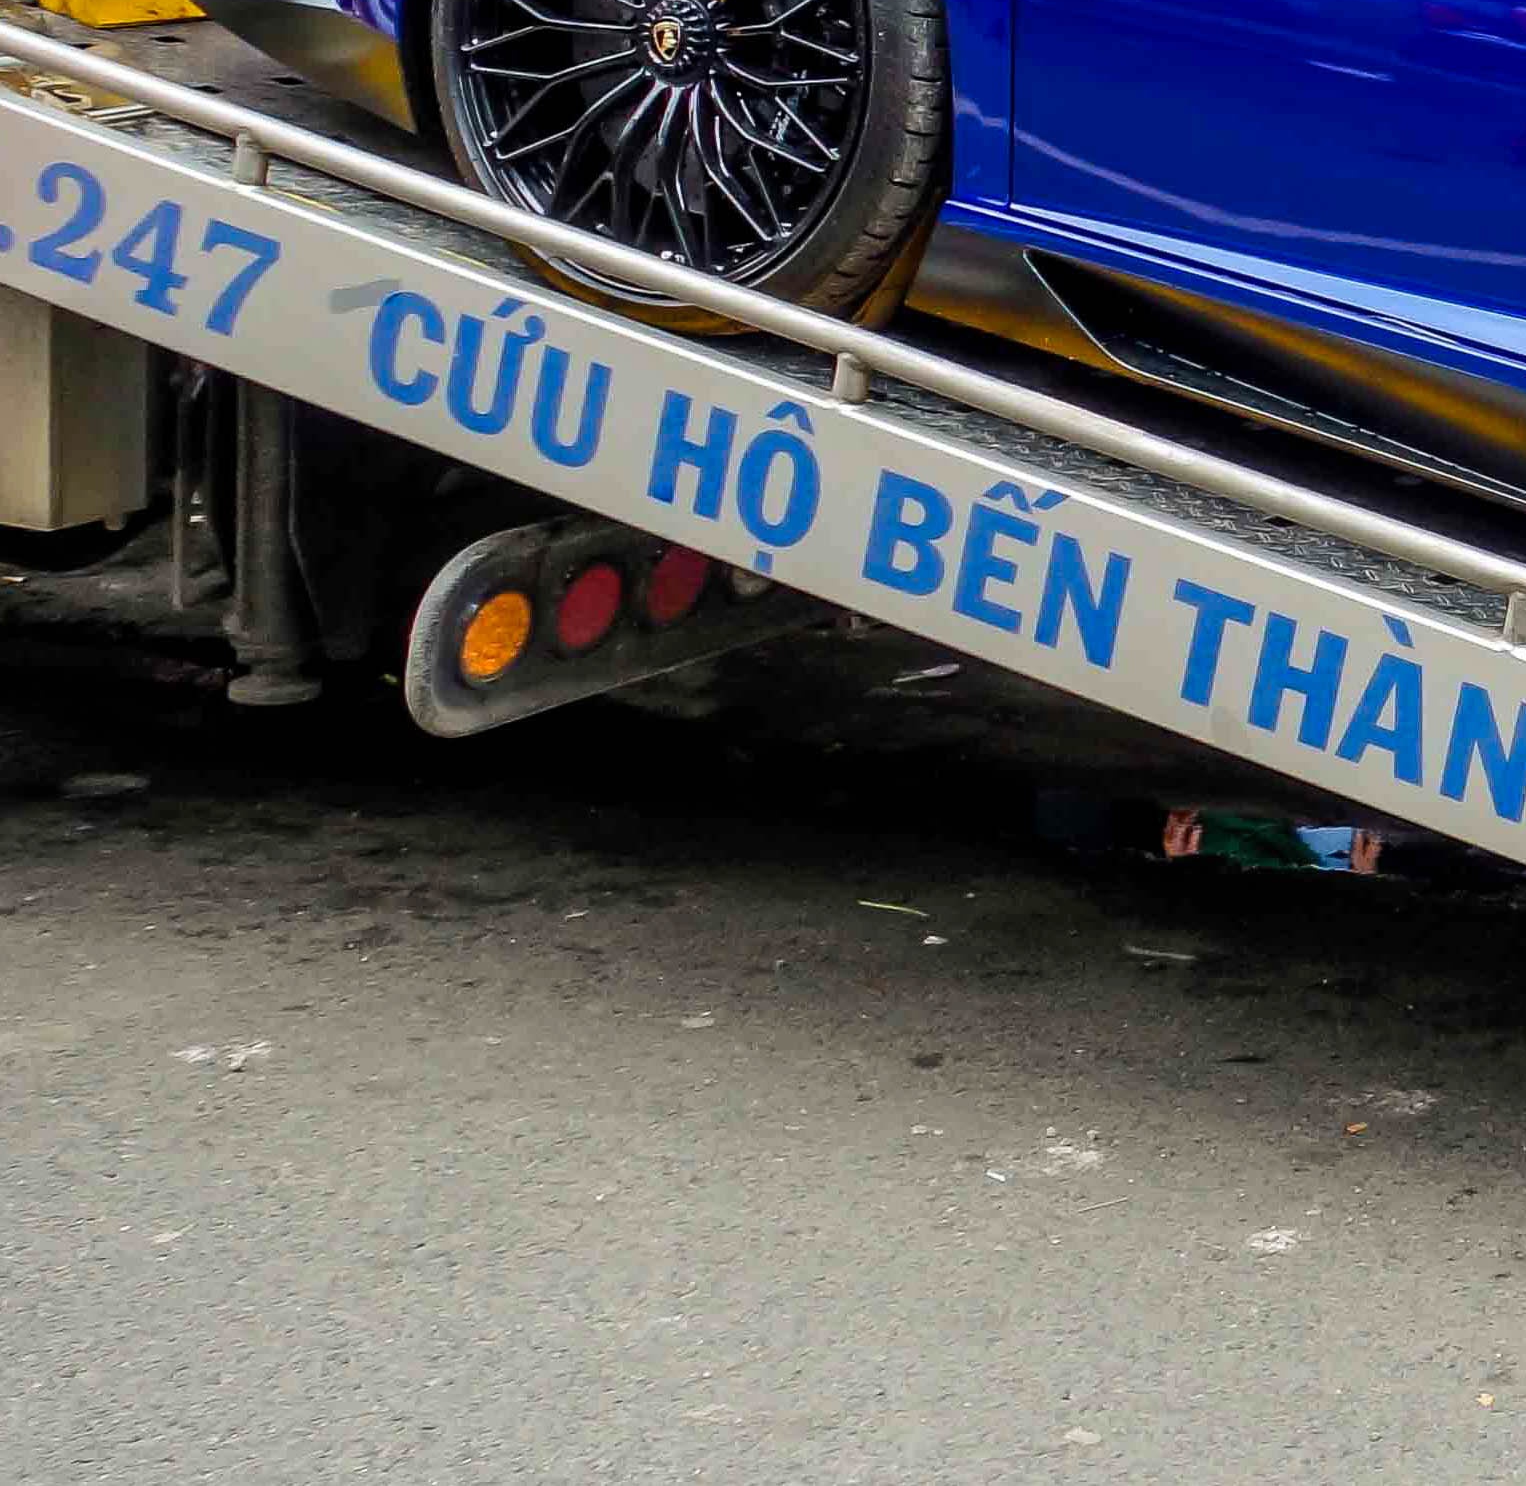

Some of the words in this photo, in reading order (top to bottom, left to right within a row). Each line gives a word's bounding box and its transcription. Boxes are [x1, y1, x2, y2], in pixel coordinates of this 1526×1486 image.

[367, 290, 612, 470] CỨU
[646, 400, 823, 575] HỘ
[861, 468, 1133, 670] BẾN
